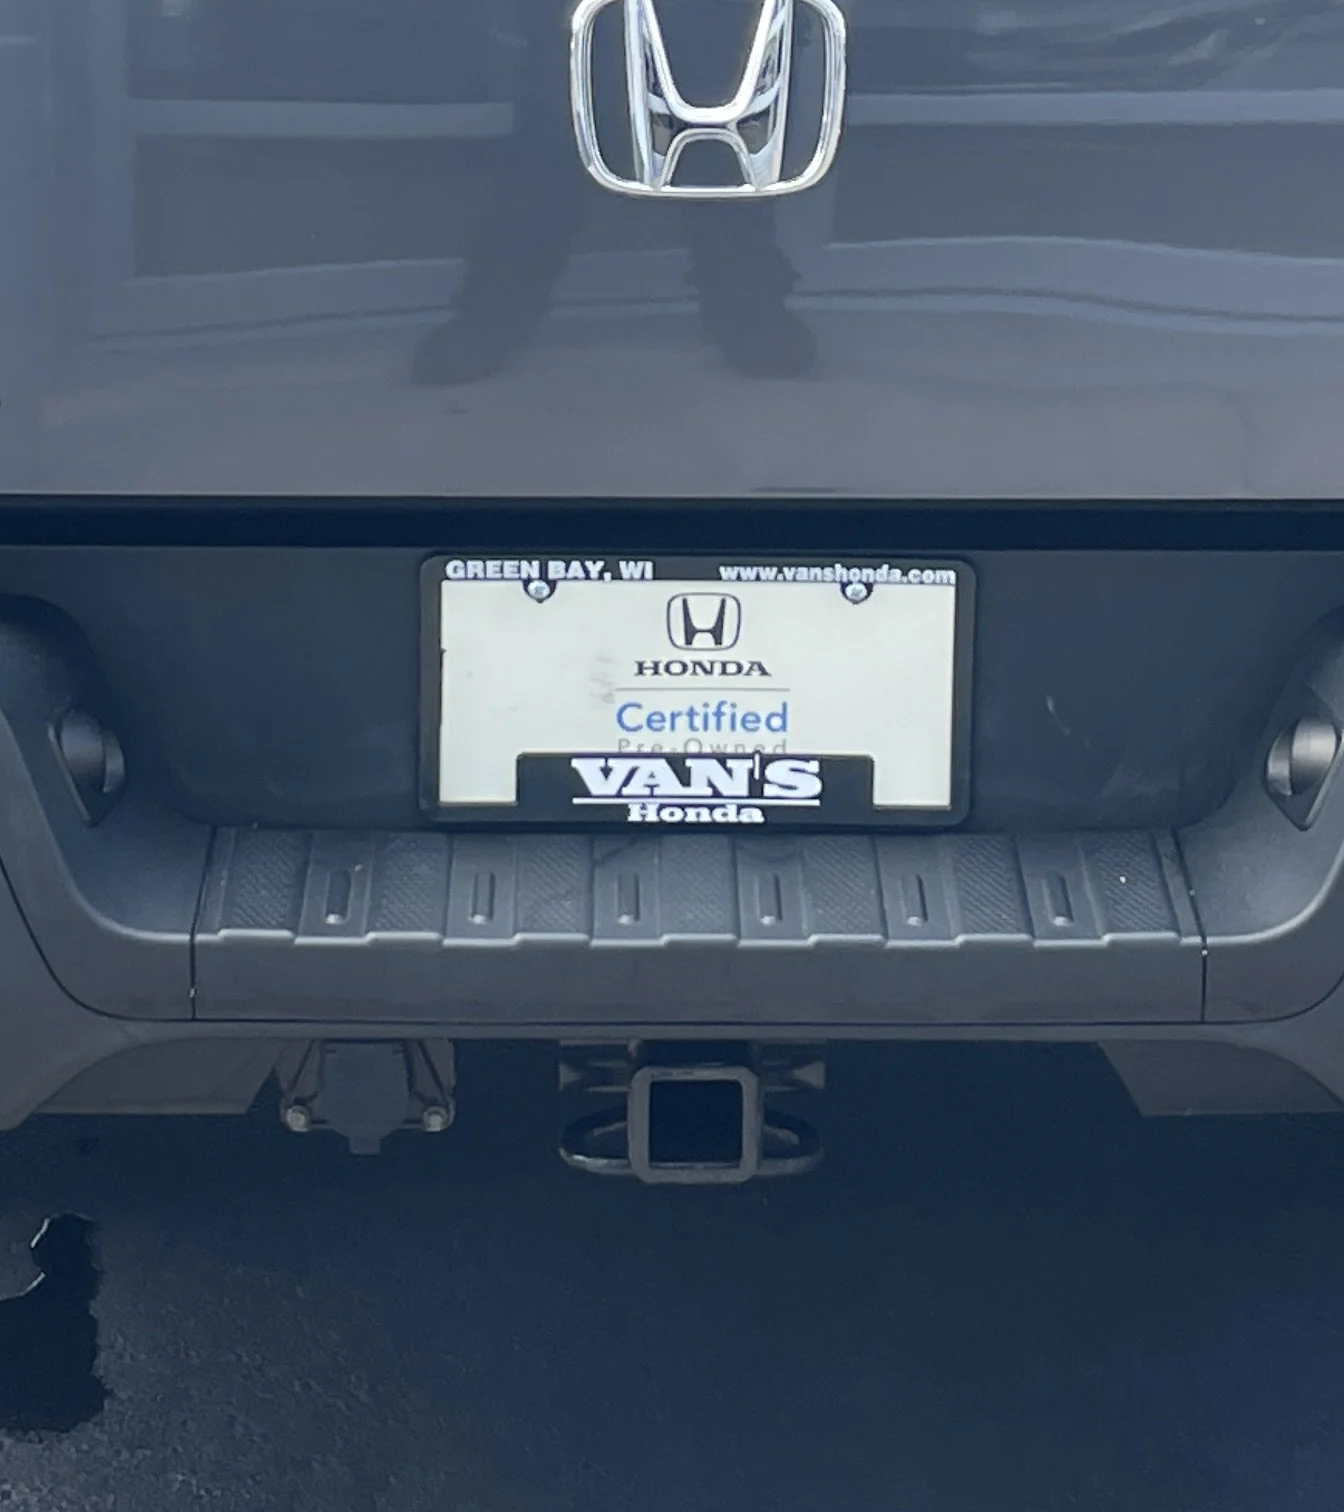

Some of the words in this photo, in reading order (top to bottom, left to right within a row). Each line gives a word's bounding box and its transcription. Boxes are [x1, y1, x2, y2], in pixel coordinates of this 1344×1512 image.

[445, 559, 540, 580] GREEN
[547, 559, 612, 583] BAY,
[619, 560, 654, 581] WI
[718, 563, 956, 584] www.vanshonda.com
[633, 659, 772, 677] HONDA
[616, 700, 788, 733] Certified
[571, 752, 823, 799] VAN'S
[627, 803, 765, 824] Honda
